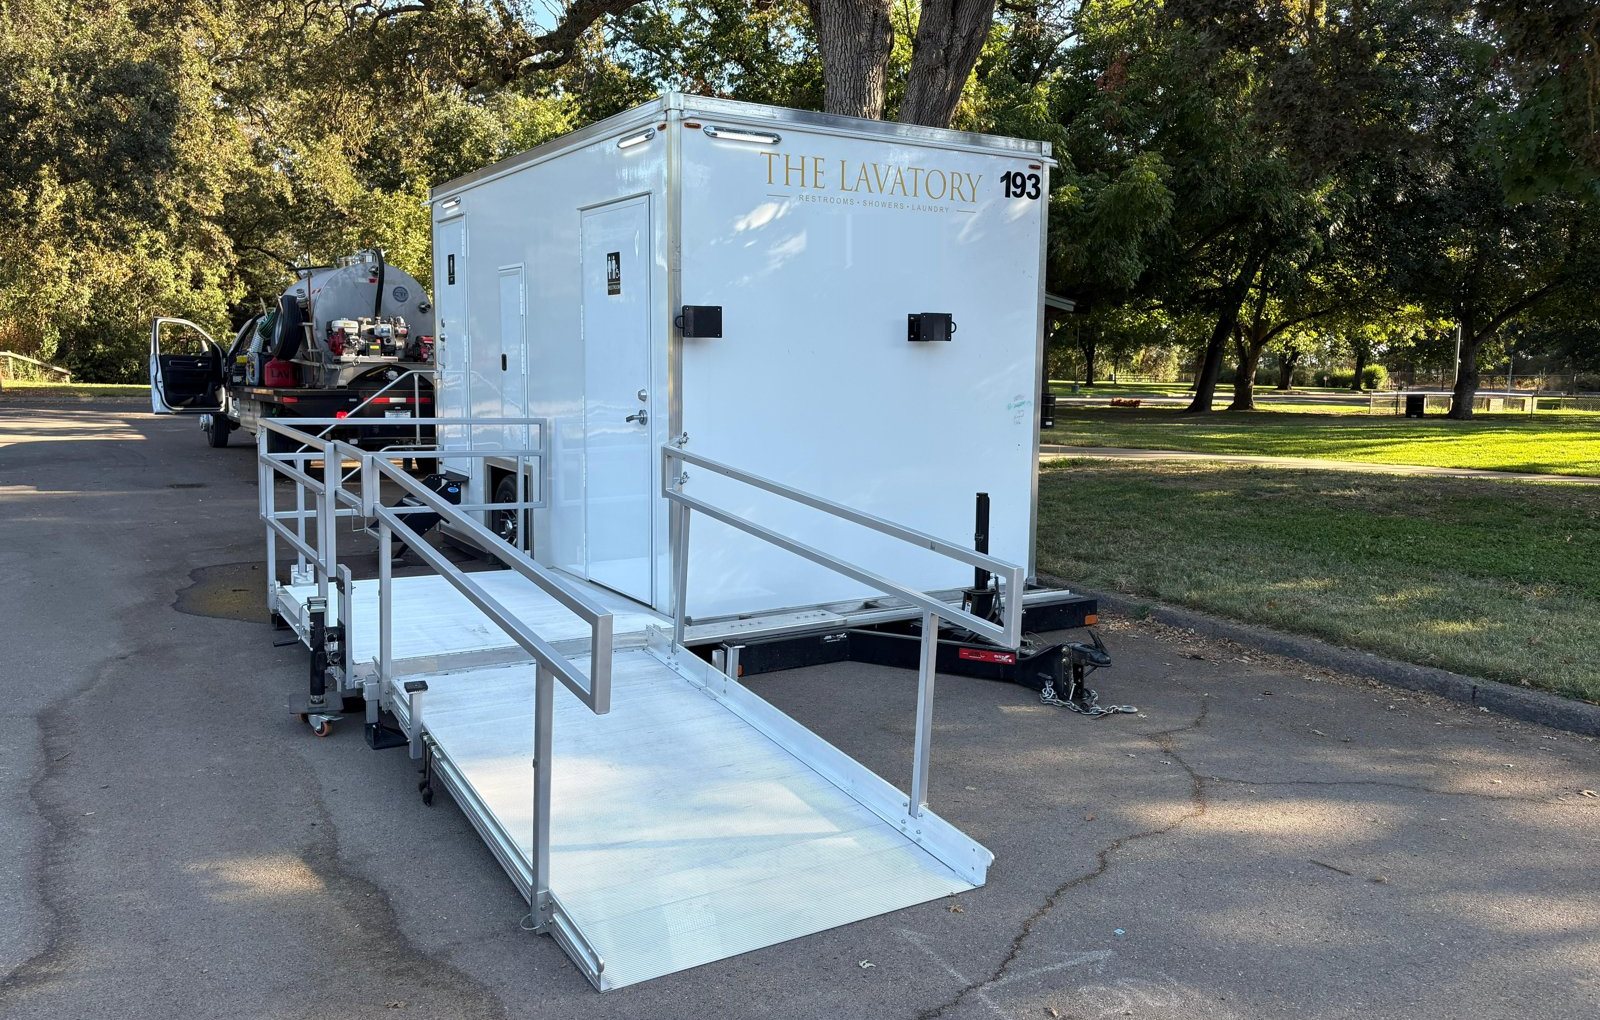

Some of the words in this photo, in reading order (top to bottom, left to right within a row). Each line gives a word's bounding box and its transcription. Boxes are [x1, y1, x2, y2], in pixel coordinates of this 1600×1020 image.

[760, 152, 825, 189] THE
[840, 160, 983, 203] LAVATORY
[1000, 171, 1041, 200] 193
[798, 194, 854, 205] RESTROOMS
[862, 199, 904, 210] SHOWERS
[911, 204, 949, 213] LAUNDRY
